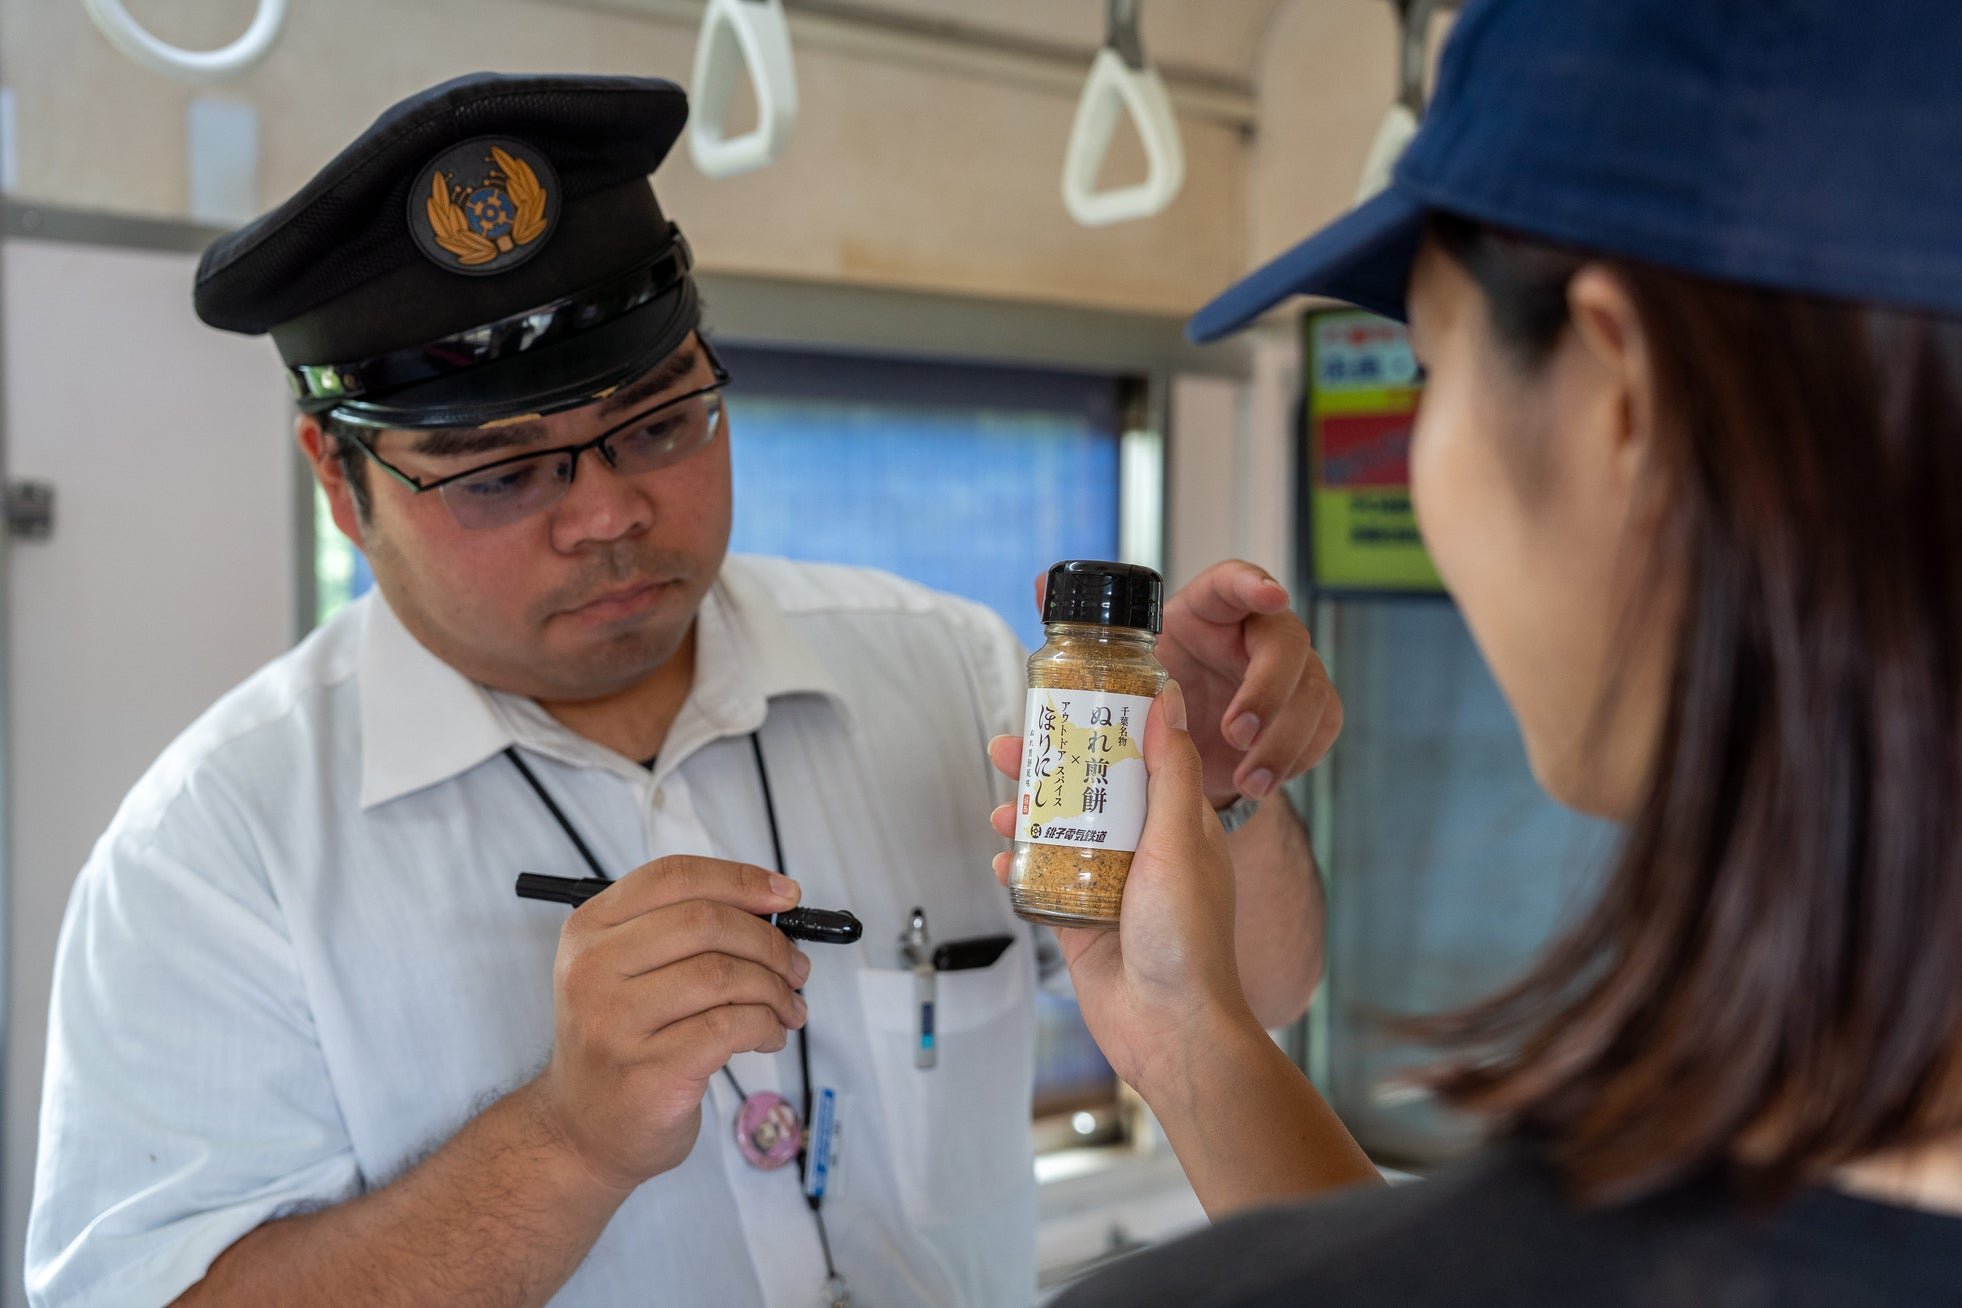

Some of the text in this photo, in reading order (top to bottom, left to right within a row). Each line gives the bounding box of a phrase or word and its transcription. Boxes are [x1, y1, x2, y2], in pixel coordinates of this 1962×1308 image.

[1034, 704, 1056, 808] ほりにし
[1053, 701, 1071, 807] アウトドア スパイス
[1081, 706, 1112, 814] ぬれ煎餅
[1118, 706, 1129, 747] 千葉名物
[1043, 827, 1108, 843] 銚子電気鉄道
